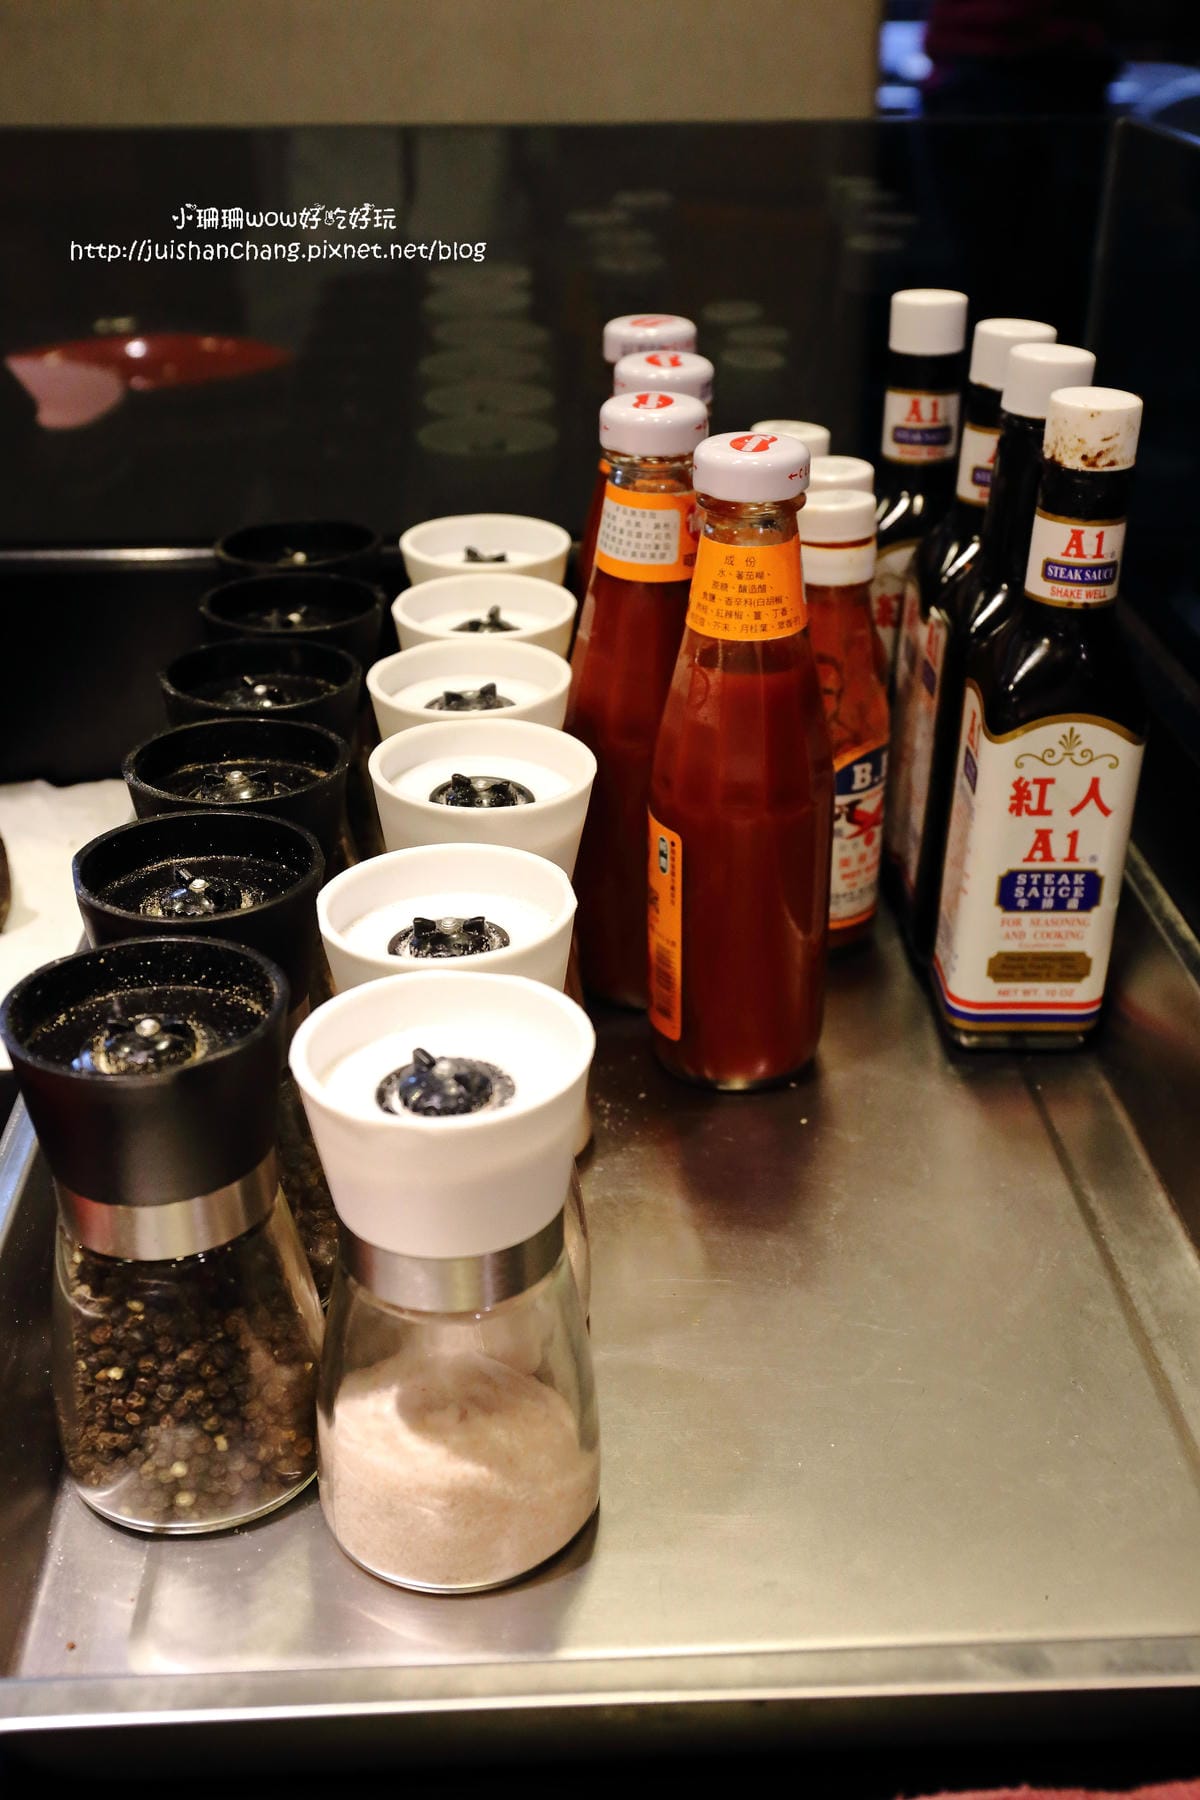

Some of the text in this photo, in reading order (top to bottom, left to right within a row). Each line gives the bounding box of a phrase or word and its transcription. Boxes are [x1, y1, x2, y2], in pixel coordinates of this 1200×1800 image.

[904, 397, 940, 423] A1
[1061, 528, 1104, 559] A1
[1047, 564, 1082, 581] STEAK
[1050, 585, 1108, 600] SHAKE WELL
[1008, 776, 1113, 818] 紅人
[1022, 828, 1080, 863] A1
[1016, 873, 1086, 885] STEAK
[1014, 886, 1085, 898] SAUCE
[1000, 917, 1091, 928] FOR SEASONING
[1003, 930, 1085, 941] AND COOKING
